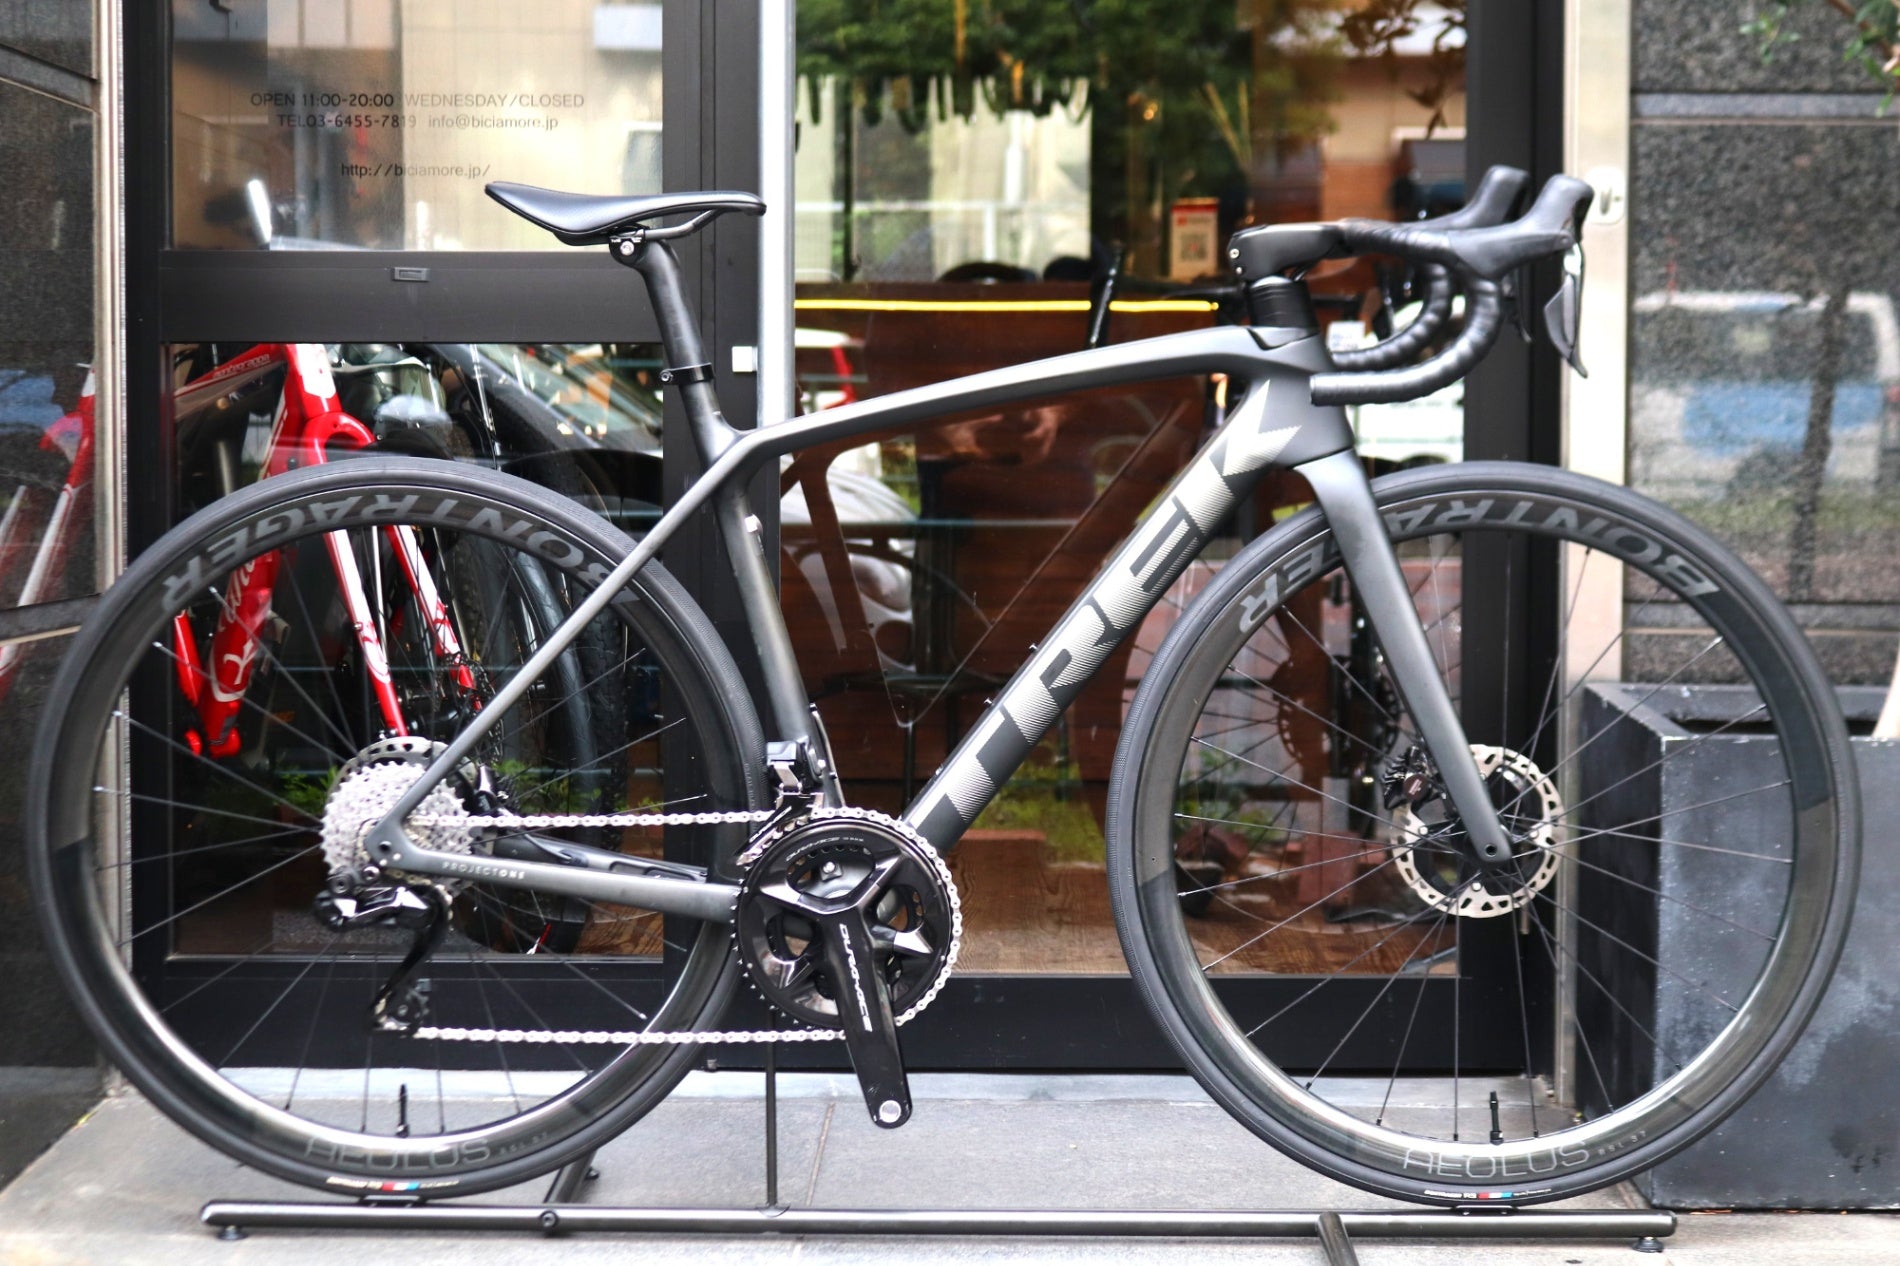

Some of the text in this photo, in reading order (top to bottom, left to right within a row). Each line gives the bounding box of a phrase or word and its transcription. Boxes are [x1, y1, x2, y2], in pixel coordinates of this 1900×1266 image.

[250, 93, 585, 108] OPEN 11:00-20:00 WEDNESDAY/CLOSED
[428, 114, 559, 131] info@biciamore.jp
[341, 163, 491, 179] http://biciamore.jp/
[1238, 499, 1720, 633] BONTRAER
[903, 380, 1301, 829] TREK
[1403, 1140, 1590, 1178] AEOLUS
